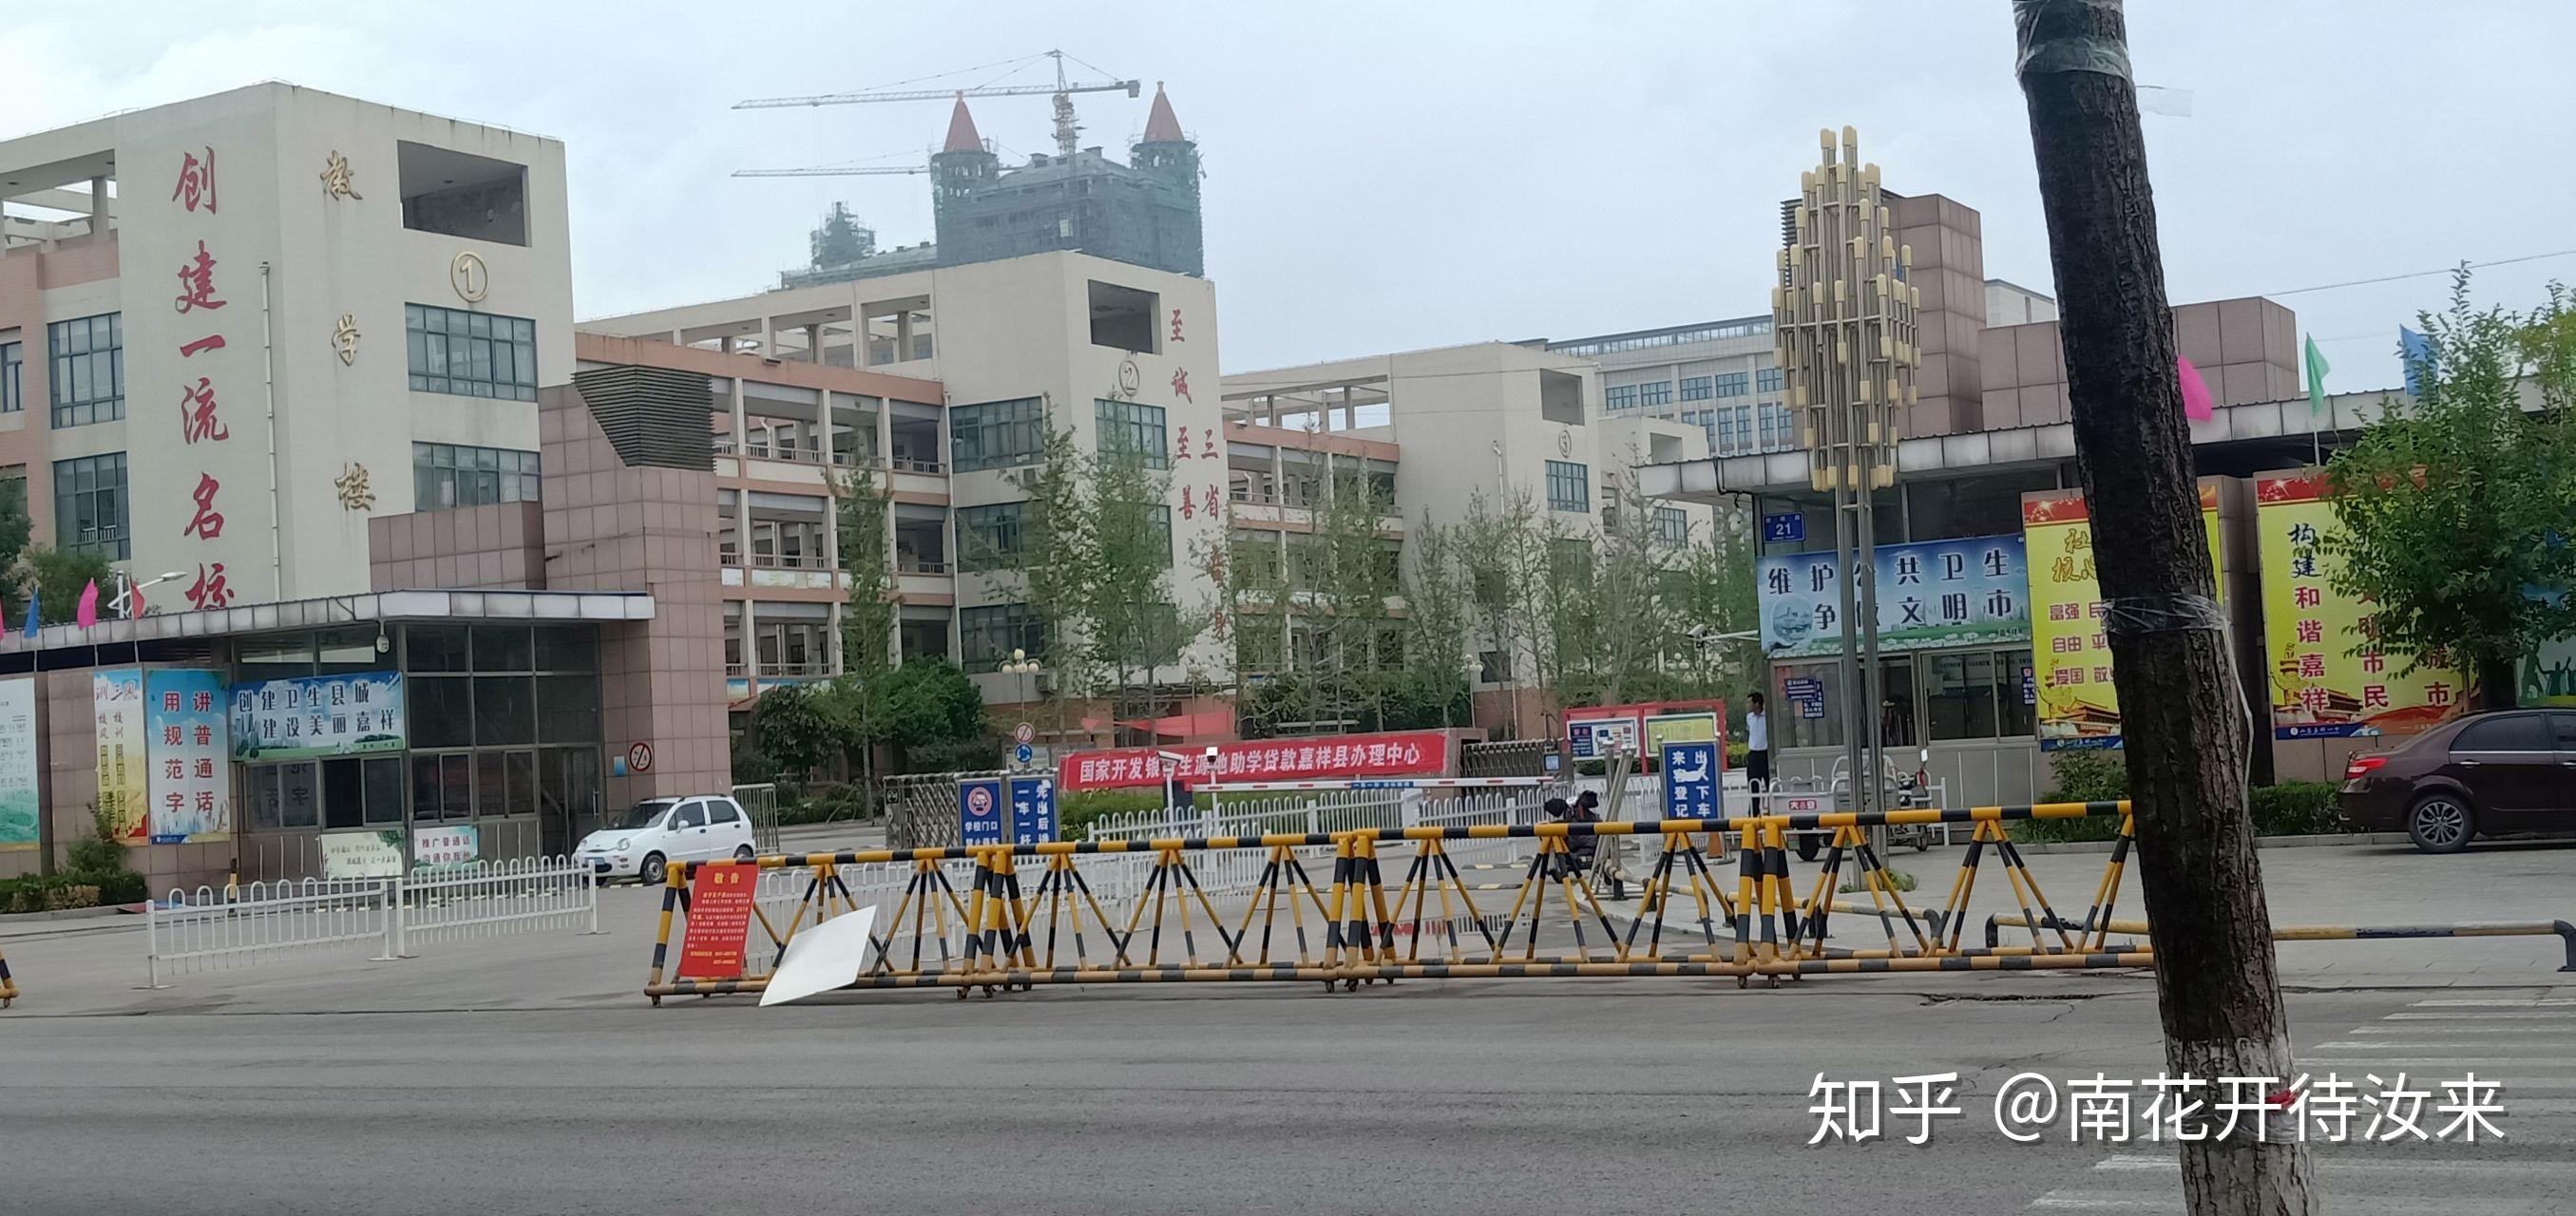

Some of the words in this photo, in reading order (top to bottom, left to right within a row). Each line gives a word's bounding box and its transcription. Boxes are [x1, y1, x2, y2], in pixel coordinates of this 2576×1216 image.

[320, 150, 376, 512] 教学楼
[172, 145, 235, 610] 创建一流名校
[1171, 309, 1197, 521] 至诚至善
[1775, 522, 1791, 535] 21
[2050, 602, 2080, 620] 富强
[2287, 523, 2330, 712] 构建和谐嘉祥
[2051, 636, 2082, 654] 自由
[2055, 667, 2085, 685] 爱国
[239, 681, 370, 712] 创建卫生县城
[263, 709, 395, 739] 建设美丽嘉祥
[163, 693, 184, 813] 用规范字
[192, 692, 215, 812] 讲普通话
[422, 836, 470, 848] 推广普通话
